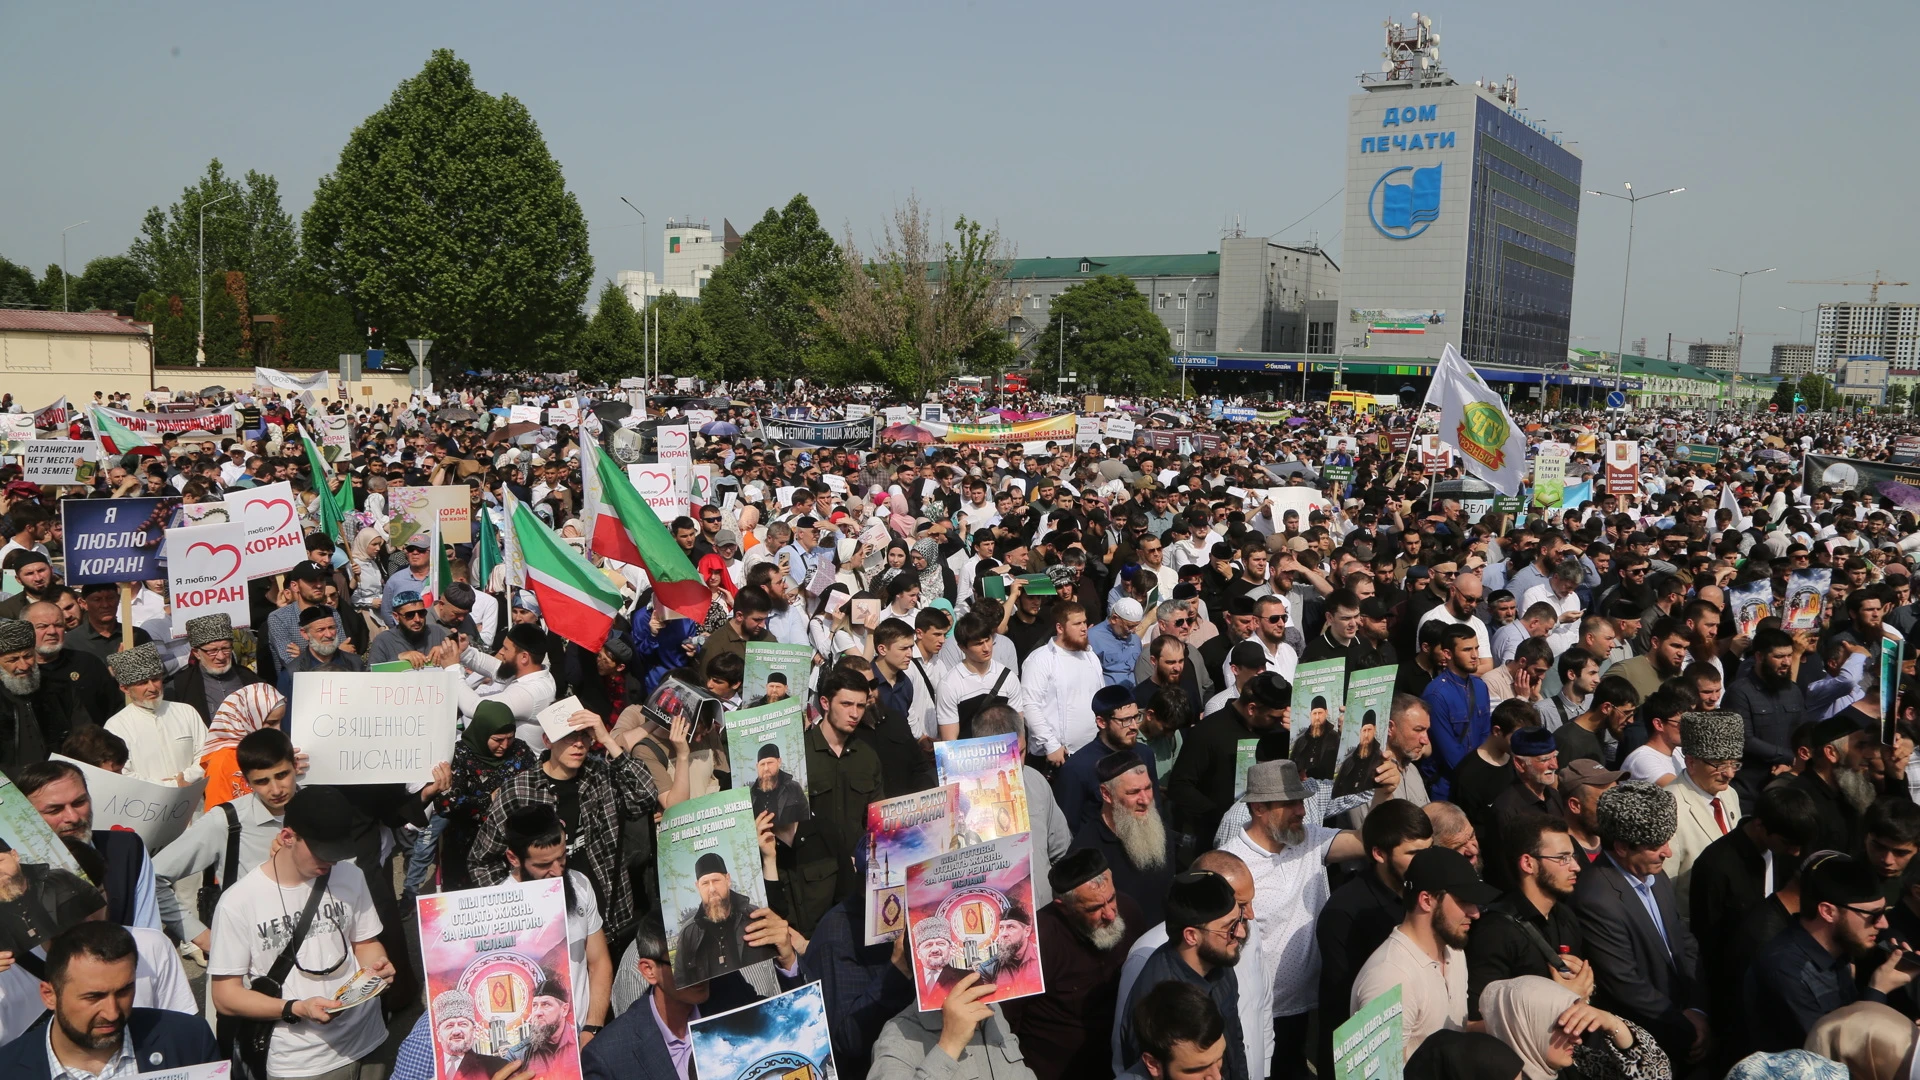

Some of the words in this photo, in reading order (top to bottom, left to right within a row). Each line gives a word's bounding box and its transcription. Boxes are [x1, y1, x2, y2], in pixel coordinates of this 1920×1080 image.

[1382, 104, 1437, 126] ДОМ
[1361, 132, 1456, 153] ПЕЧАТИ
[766, 426, 784, 439] НАША
[784, 426, 816, 440] РЕЛИГИЯ
[822, 426, 842, 440] НАША
[844, 426, 870, 439] ЖИЗНЬ!
[952, 424, 1014, 434] КОРАН
[1034, 427, 1074, 437] жизнь!
[1472, 411, 1502, 442] ЧГУ
[660, 450, 688, 458] КОРАН
[1460, 436, 1494, 465] ГРОЗНЫЙ
[1894, 475, 1920, 486] Наш
[646, 497, 674, 508] ОРАН
[1463, 503, 1492, 514] РЕЛИ
[104, 508, 117, 524] Я
[74, 530, 148, 550] ЛЮБЛЮ
[248, 524, 276, 536] люблю
[246, 531, 301, 556] КОРАН
[78, 556, 144, 576] КОРАН!
[176, 578, 183, 586] Я
[185, 575, 217, 584] люблю
[176, 585, 245, 609] КОРАН
[370, 686, 444, 706] ТРОГАТЬ
[312, 714, 426, 739] СВЯЩЕННОЕ
[726, 720, 737, 729] МЫ
[738, 717, 761, 726] ГОТОВЫ
[762, 710, 783, 721] ОТДАТЬ
[784, 705, 801, 715] ЖИЗНЬ
[750, 725, 765, 735] НАШУ
[766, 718, 790, 730] РЕЛИГИЮ
[759, 732, 777, 742] ИСЛАМ
[948, 750, 954, 760] Я
[957, 741, 1007, 758] ЛЮБЛЮ
[956, 754, 1001, 772] КОРАН!
[104, 795, 190, 821] ЛЮБЛЮ
[880, 799, 918, 818] ПРОЧЬ
[920, 790, 947, 807] РУКИ
[658, 822, 670, 833] МЫ
[670, 814, 695, 828] ГОТОВЫ
[696, 806, 723, 821] ОТДАТЬ
[724, 800, 752, 814] ЖИЗНЬ
[883, 816, 898, 831] ОТ
[901, 804, 945, 828] КОРАНА!
[672, 832, 680, 843] ЗА
[681, 826, 700, 840] НАШУ
[702, 817, 736, 834] РЕЛИГИЮ
[694, 836, 719, 852] ИСЛАМ
[941, 854, 957, 864] МЫ
[958, 844, 996, 860] ГОТОВЫ
[924, 878, 936, 886] ЗА
[938, 870, 965, 884] НАШУ
[966, 860, 1010, 876] РЕЛИГИЮ
[933, 861, 968, 875] ОТДАТЬ
[970, 853, 1003, 868] ЖИЗНЬ
[952, 876, 986, 889] ИСЛАМ!
[459, 896, 478, 910] МЫ
[480, 889, 523, 907] ГОТОВЫ
[451, 910, 493, 926] ОТДАТЬ
[495, 903, 533, 919] ЖИЗНЬ
[442, 928, 456, 942] ЗА
[459, 924, 488, 940] НАШУ
[493, 916, 543, 934] РЕЛИГИЮ
[475, 936, 516, 952] ИСЛАМ!
[1344, 1028, 1363, 1055] ГОТОВЫ
[1364, 1014, 1382, 1038] ОТДАТЬ
[1383, 1002, 1402, 1023] ЖИЗНЬ
[1346, 1057, 1354, 1074] ЗА
[1354, 1044, 1368, 1067] НАШУ
[1368, 1026, 1390, 1055] РЕЛИГИЮ
[1364, 1055, 1380, 1080] ИСЛАМ
